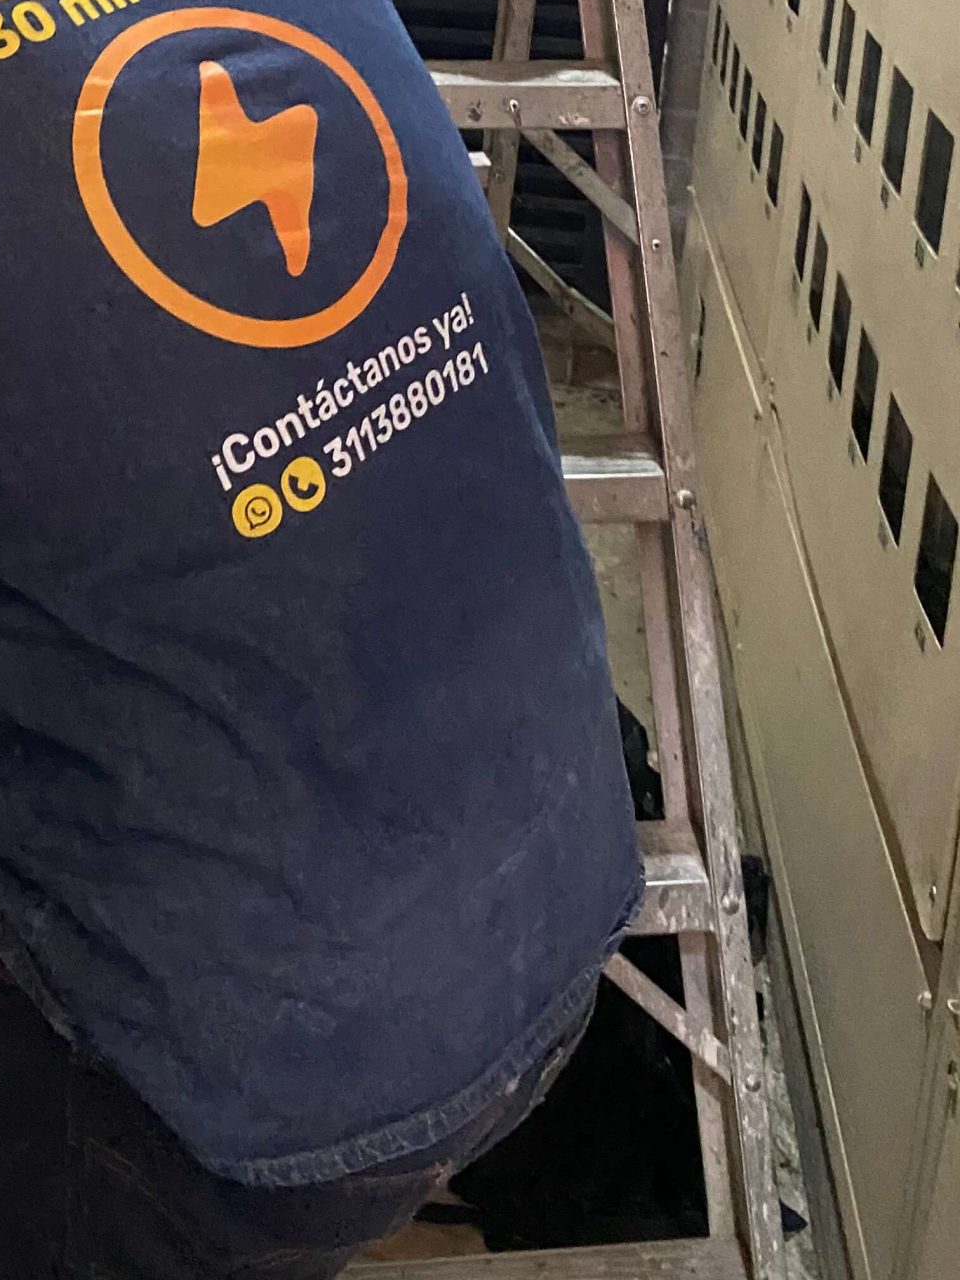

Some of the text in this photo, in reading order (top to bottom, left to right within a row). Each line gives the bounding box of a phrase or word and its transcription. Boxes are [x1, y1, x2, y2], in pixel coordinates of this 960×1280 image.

[211, 291, 475, 492] ¡Contáctanos ya!
[322, 341, 489, 478] 3113880181
